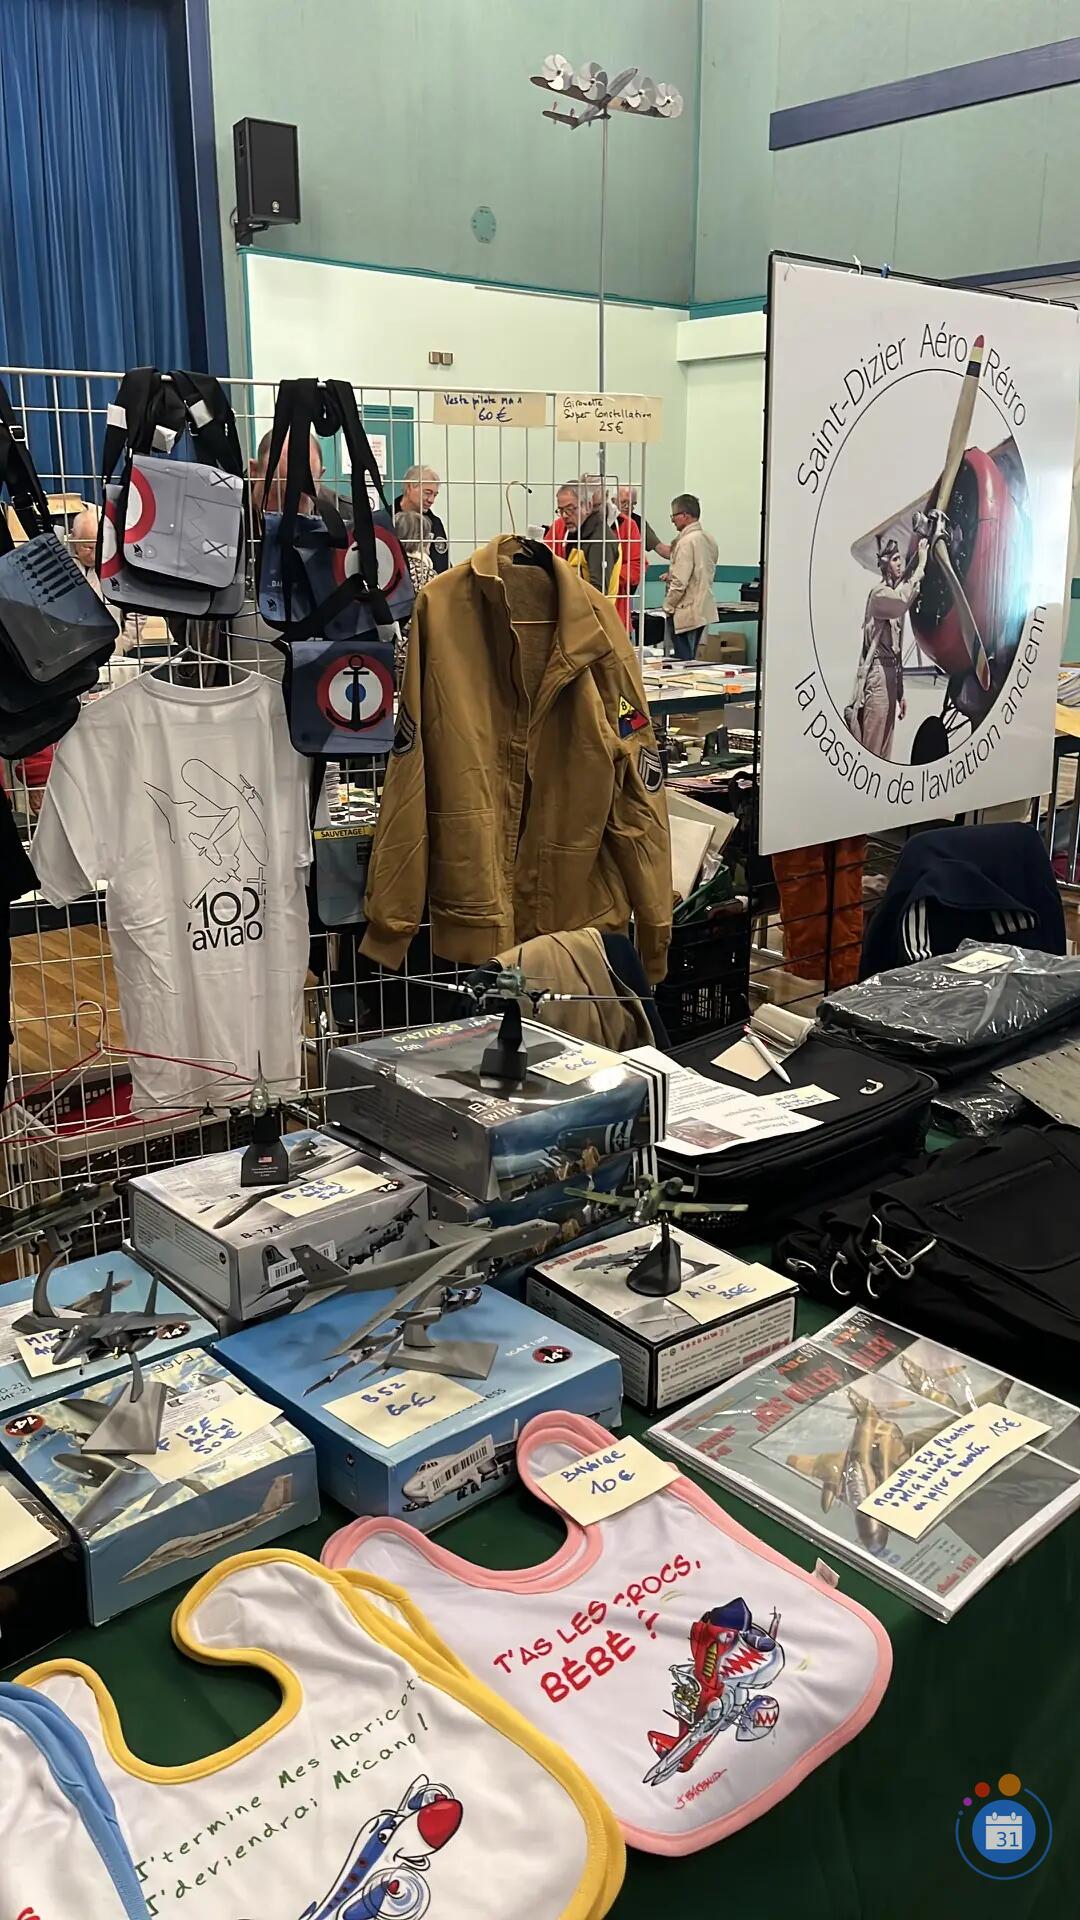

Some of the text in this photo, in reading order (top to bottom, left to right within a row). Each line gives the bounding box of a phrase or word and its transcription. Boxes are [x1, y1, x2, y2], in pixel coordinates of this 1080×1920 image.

[444, 394, 471, 405] Veste
[472, 394, 499, 412] pilote
[478, 408, 493, 421] 60
[563, 397, 603, 407] Girouette
[797, 322, 1026, 493] Saint-Dizier Aéro Rétro
[564, 410, 652, 424] Super Constellation
[600, 421, 624, 434] 25€
[795, 604, 1047, 804] la passion de l'aviation ancienn
[321, 828, 363, 838] SAUVETAGE
[151, 1354, 194, 1373] F15E
[874, 1468, 917, 1506] Maquette
[493, 1637, 554, 1675] T'AS
[557, 1600, 608, 1645] LES
[541, 1629, 636, 1703] BÉBÉ
[134, 1675, 416, 1883] J'termine Mes Haricot
[143, 1797, 321, 1917] J'deviendrai
